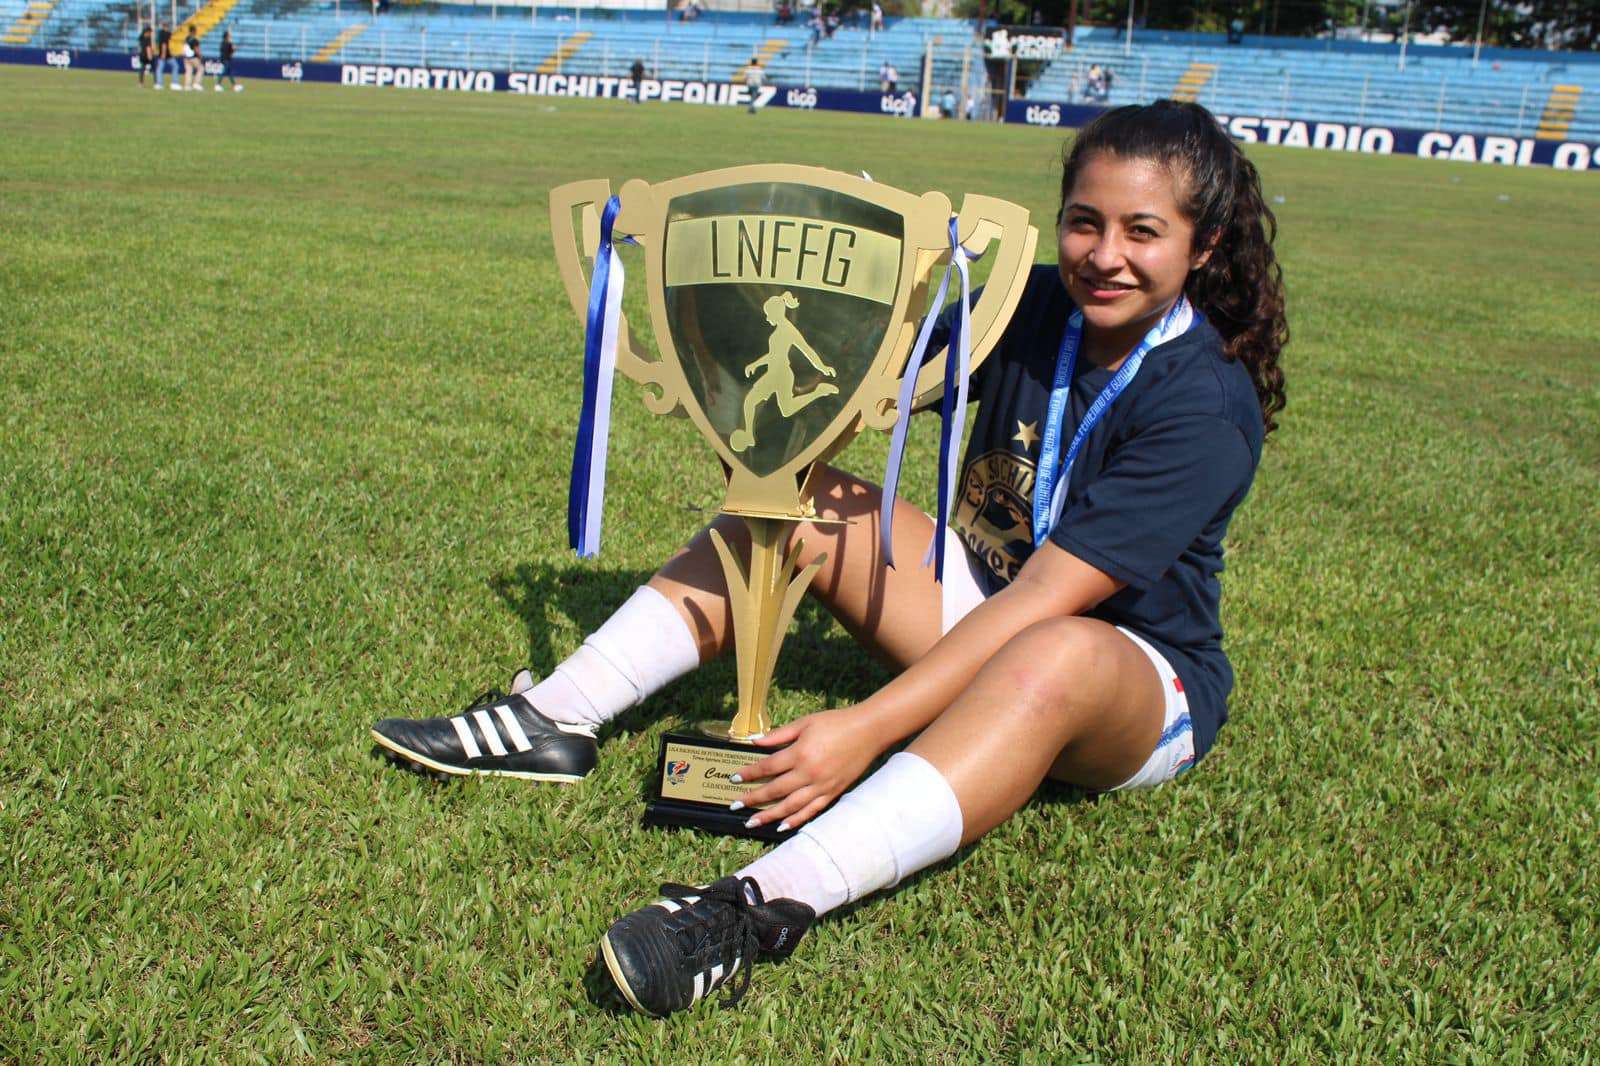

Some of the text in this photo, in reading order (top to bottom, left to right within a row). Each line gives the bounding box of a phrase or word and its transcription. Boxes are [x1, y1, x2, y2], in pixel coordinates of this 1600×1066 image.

[341, 65, 495, 93] DEPORTIVO
[711, 219, 857, 287] LNFFG
[1100, 385, 1115, 400] DE
